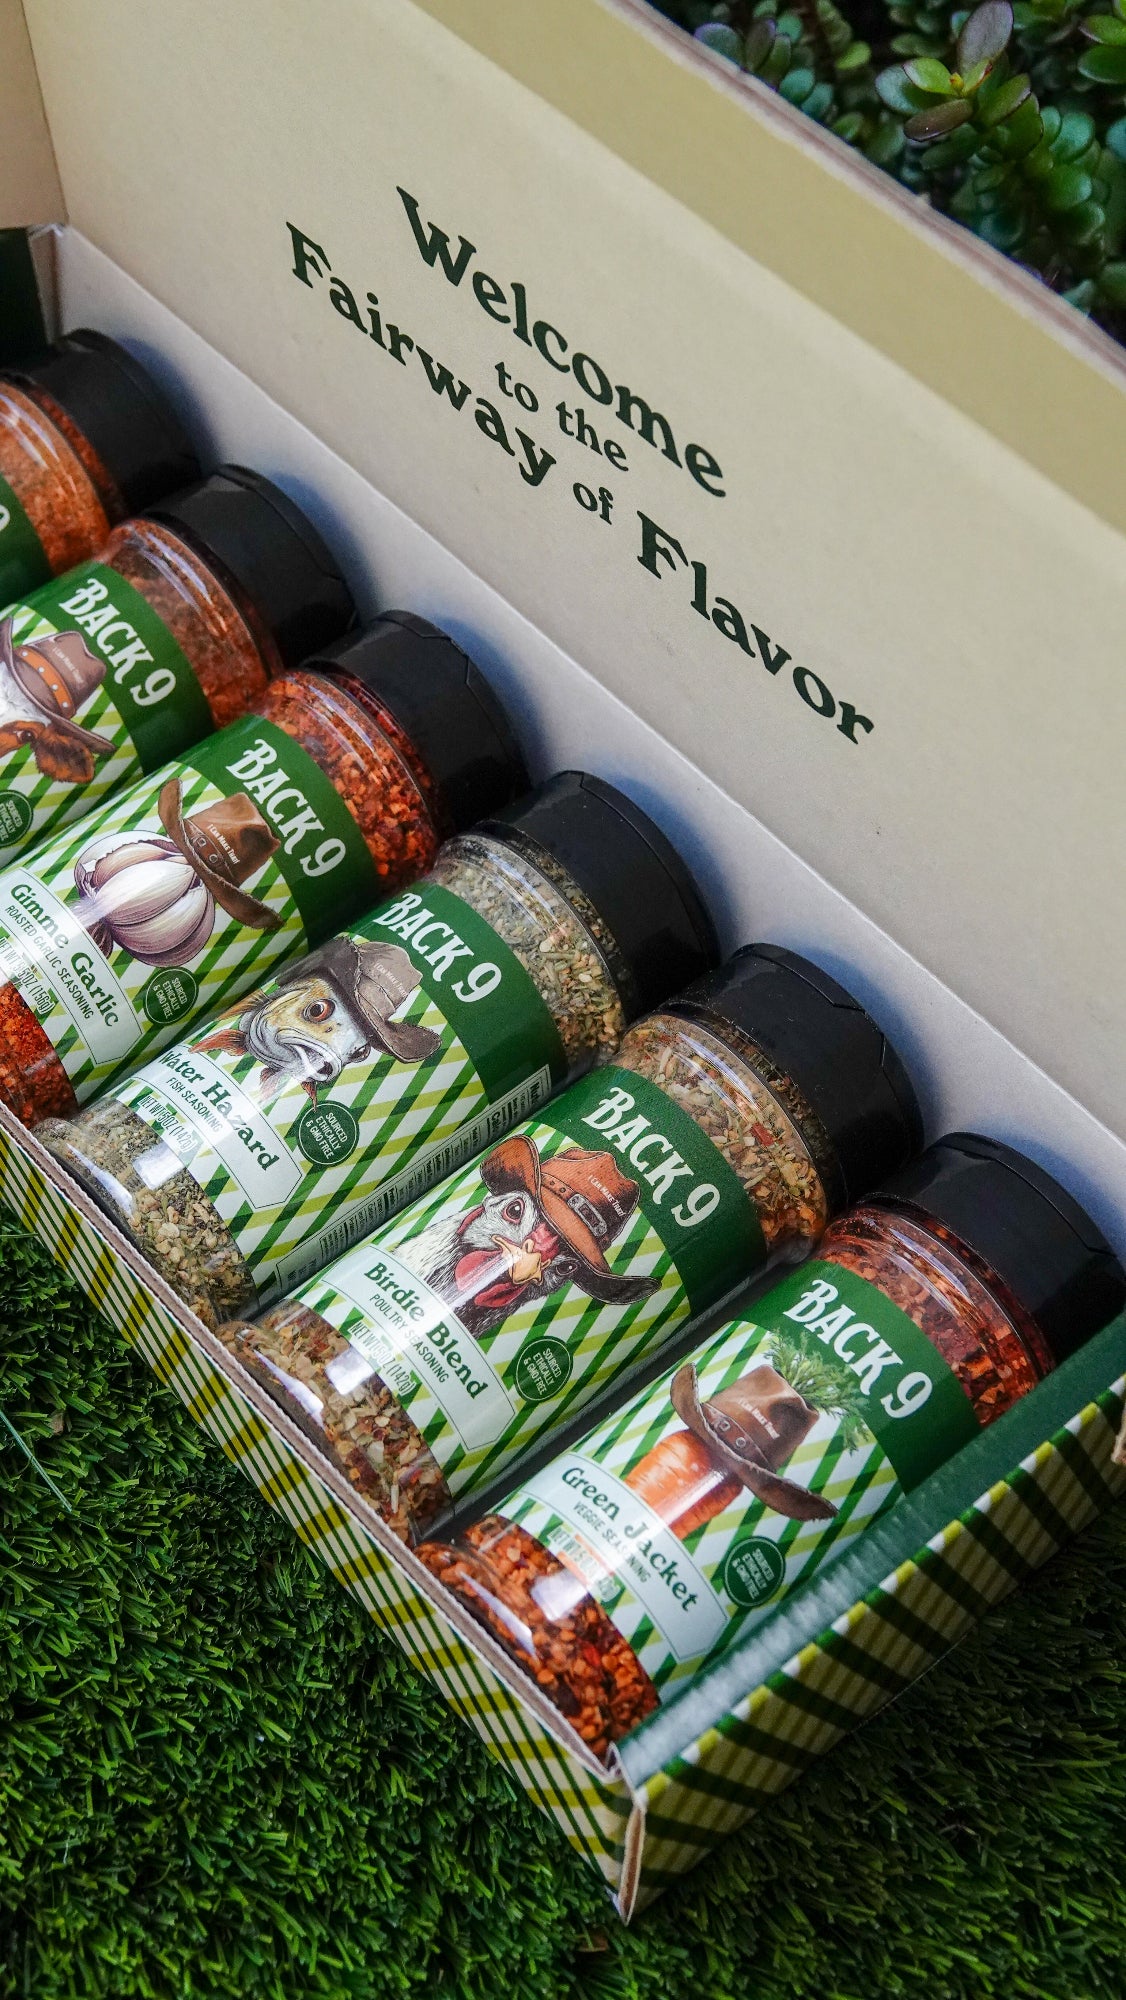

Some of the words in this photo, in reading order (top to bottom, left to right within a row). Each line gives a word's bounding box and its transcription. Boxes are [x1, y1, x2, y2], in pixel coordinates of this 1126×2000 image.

[397, 186, 726, 497] Welcome
[495, 362, 538, 412] to
[554, 401, 629, 471] the
[286, 222, 556, 486] Fairway
[573, 482, 614, 525] of
[637, 510, 874, 744] Flavor
[59, 578, 154, 684] BACK
[130, 669, 176, 706] 9
[210, 826, 221, 838] CAN
[217, 835, 230, 851] MAKE
[225, 739, 325, 855] BACK
[300, 838, 346, 877] 9
[5, 905, 37, 937] ROASTED
[33, 935, 62, 969] GARLIC
[57, 967, 94, 1020] SEASONING
[10, 884, 69, 949] Gimme
[70, 952, 119, 1027] Garlic
[373, 893, 474, 982] BACK
[451, 962, 502, 1003] 9
[28, 985, 54, 1014] (156g)
[156, 990, 166, 1004] GMO
[162, 1003, 173, 1019] FREE
[163, 981, 180, 1010] ETHICALLY
[171, 977, 187, 1005] SOURCED
[140, 1096, 158, 1109] NET
[149, 1103, 166, 1117] WT
[169, 1125, 197, 1152] (142g)
[158, 1050, 205, 1084] Water
[202, 1081, 280, 1171] Hazard
[166, 1077, 185, 1094] FISH
[181, 1090, 224, 1133] SEASONING
[316, 1116, 341, 1150] ETHICALLY
[325, 1112, 348, 1142] SOURCED
[310, 1126, 323, 1141] GMO
[319, 1140, 334, 1159] FREE
[581, 1087, 694, 1204] BACK
[671, 1184, 720, 1227] 9
[591, 1178, 602, 1190] CAN
[600, 1186, 615, 1202] MAKE
[350, 1322, 371, 1339] NET
[363, 1333, 380, 1351] WT
[386, 1364, 415, 1395] (142g)
[364, 1262, 424, 1322] Birdie
[426, 1321, 488, 1399] Blend
[370, 1294, 408, 1330] POULTRY
[405, 1329, 450, 1383] SEASONING
[524, 1357, 531, 1365] &
[543, 1348, 561, 1377] SOURCED
[783, 1280, 903, 1395] BACK
[880, 1372, 933, 1418] 9
[527, 1363, 539, 1379] GMO
[533, 1352, 555, 1385] ETHICALLY
[534, 1377, 547, 1395] FREE
[562, 1467, 620, 1521] Green
[624, 1521, 698, 1612] Jacket
[573, 1501, 606, 1532] VEGGIE
[602, 1528, 651, 1584] SEASNING
